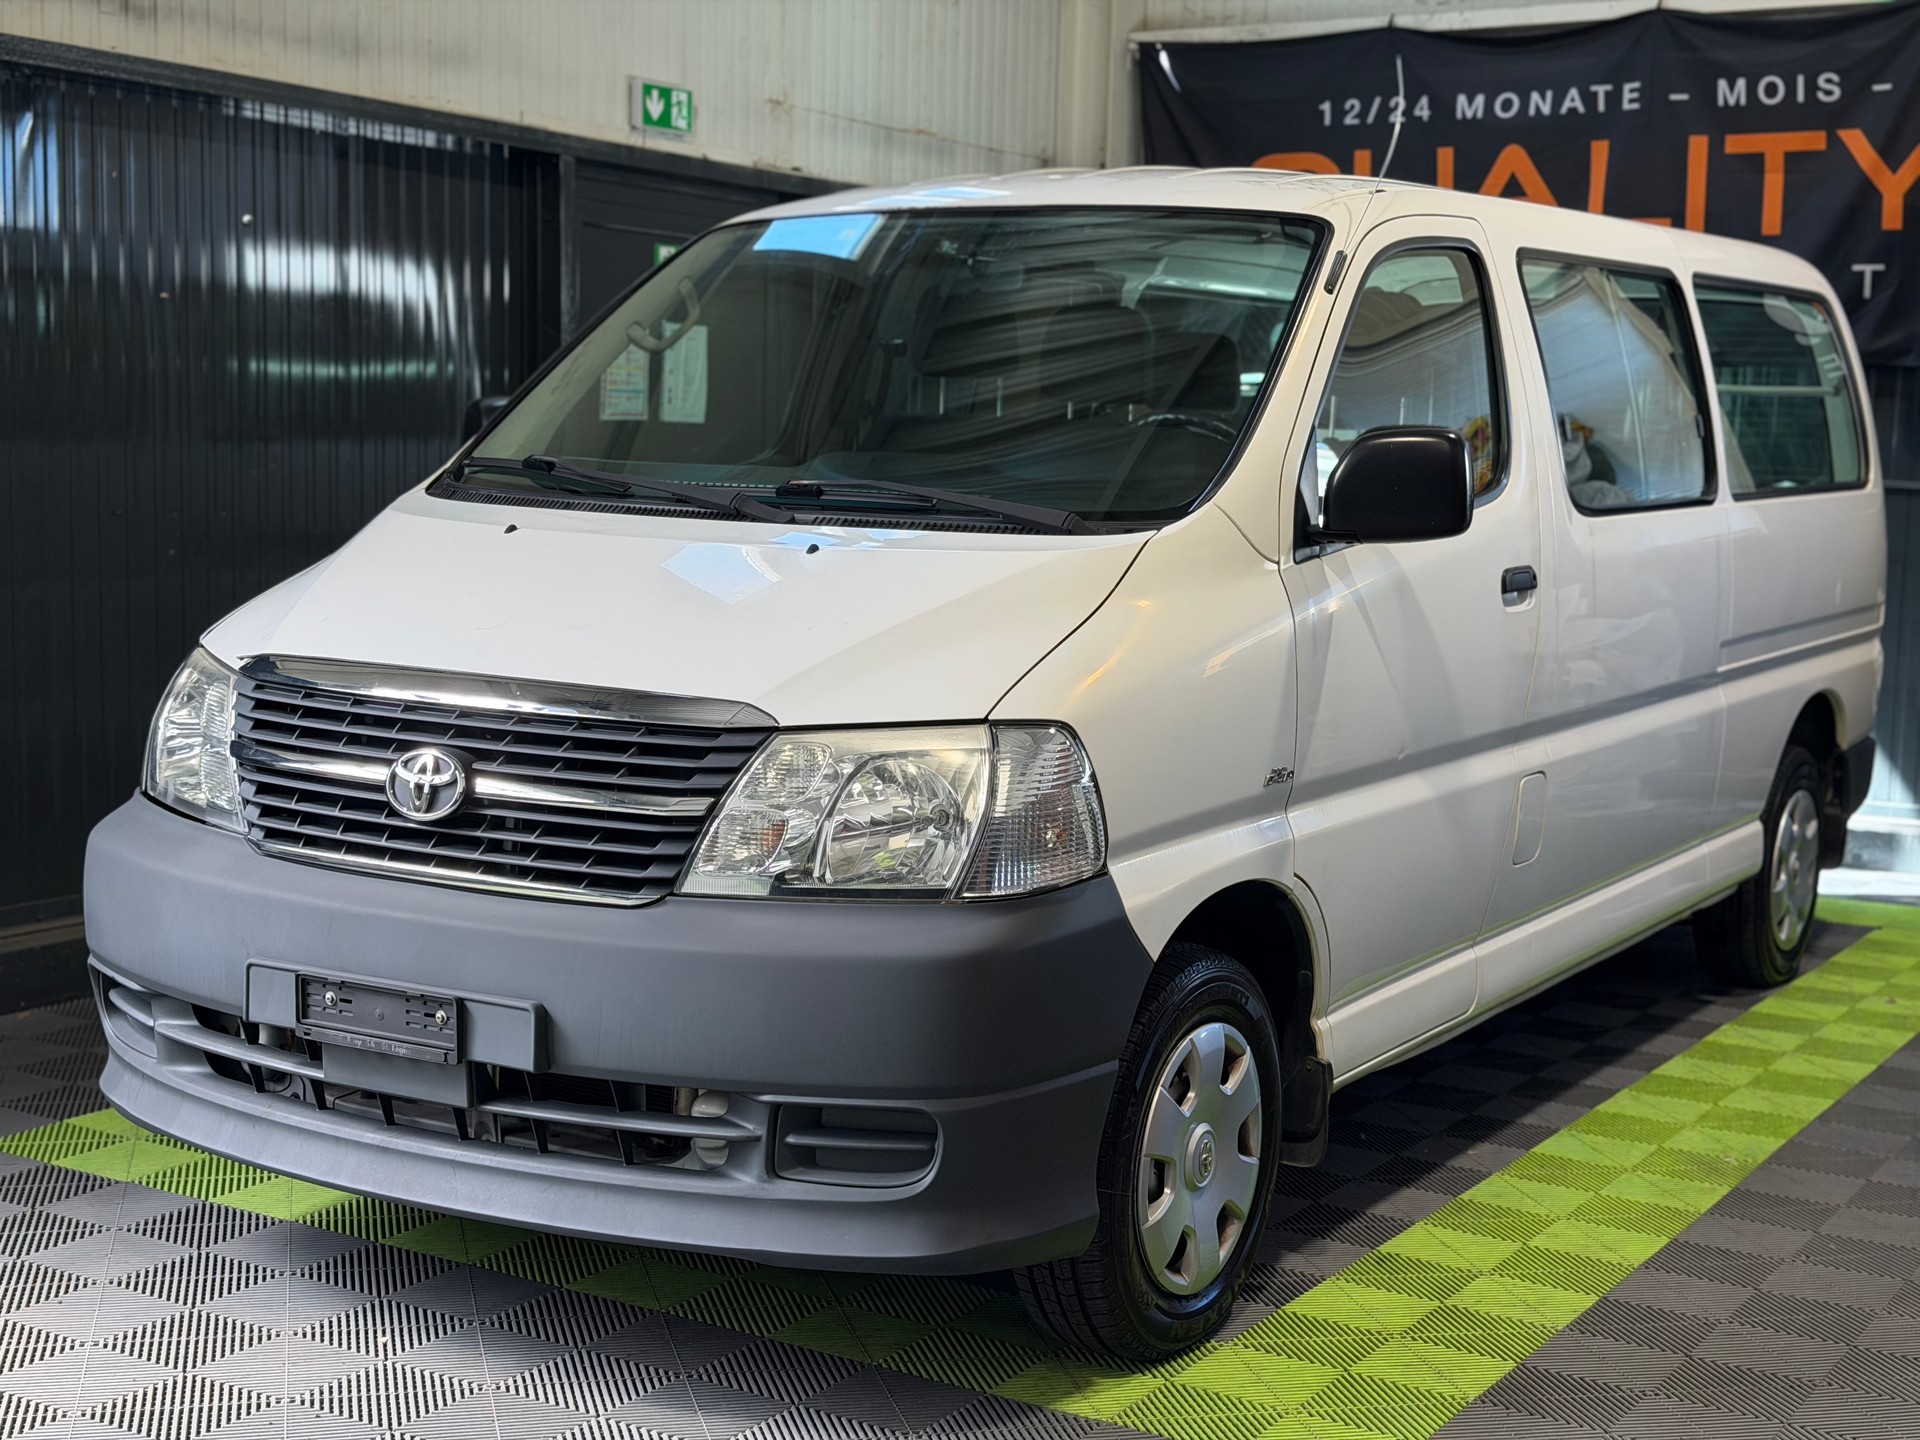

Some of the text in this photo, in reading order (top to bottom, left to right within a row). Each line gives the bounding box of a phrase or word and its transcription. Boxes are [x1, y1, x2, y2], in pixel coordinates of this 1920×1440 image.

[1317, 93, 1432, 127] 12/24
[1455, 81, 1643, 120] MONATE
[1716, 71, 1843, 108] MOIS
[1251, 127, 1920, 237] ALITY
